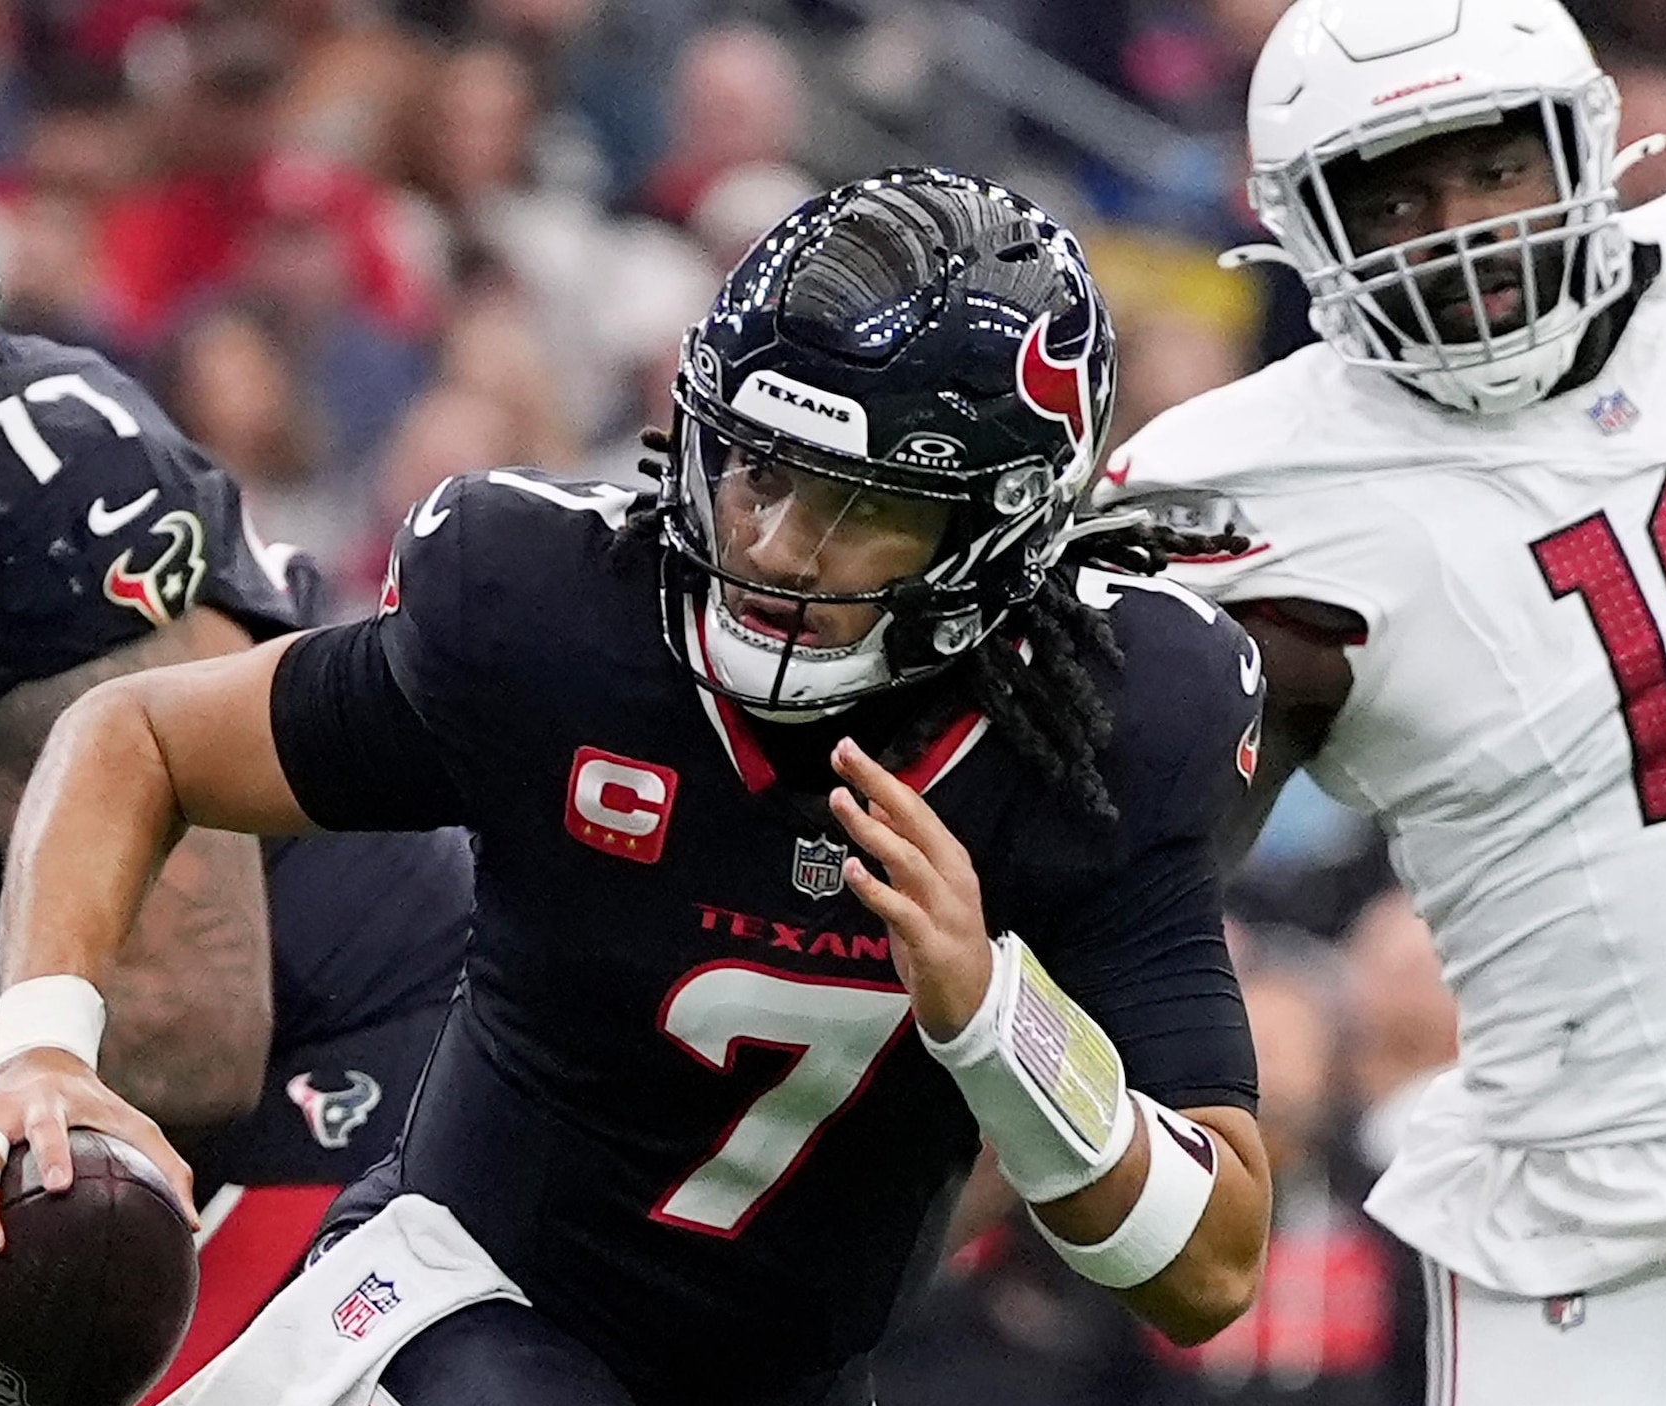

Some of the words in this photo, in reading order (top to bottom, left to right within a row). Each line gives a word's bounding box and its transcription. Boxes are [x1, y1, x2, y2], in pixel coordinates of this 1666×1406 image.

[756, 378, 851, 423] TEXANS
[896, 451, 963, 468] OAKLEY
[574, 759, 667, 836] C
[798, 864, 838, 888] NFL
[695, 902, 890, 960] TEXAN
[648, 957, 916, 1240] 7
[336, 1294, 377, 1338] NFL
